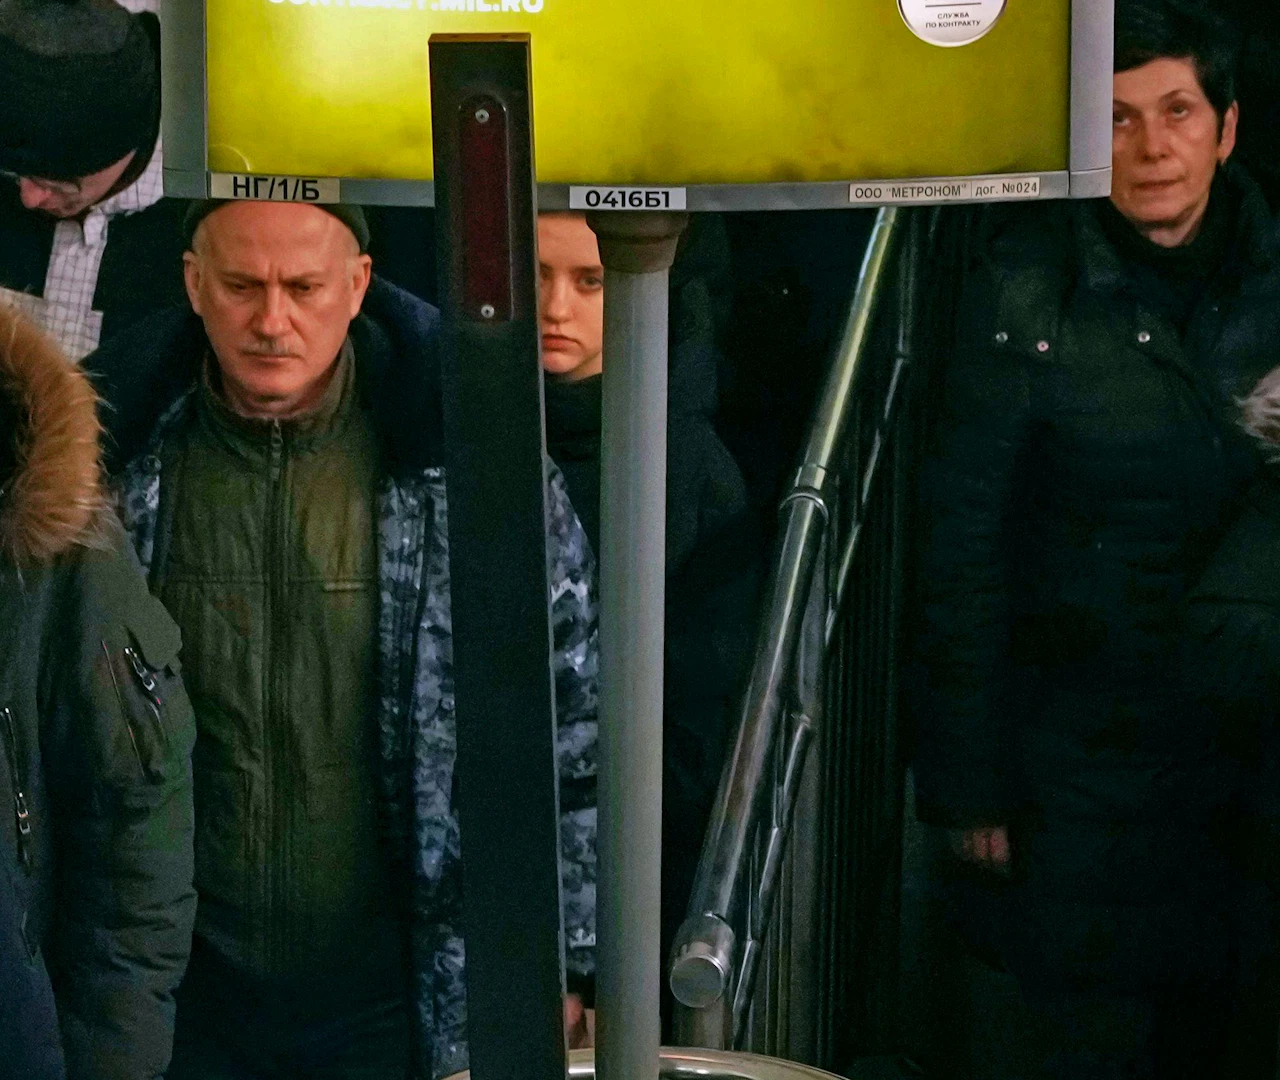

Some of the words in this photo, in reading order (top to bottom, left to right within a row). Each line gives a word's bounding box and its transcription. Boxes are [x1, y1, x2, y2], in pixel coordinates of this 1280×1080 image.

[937, 12, 970, 20] СЛУЖБА
[938, 20, 981, 28] КОНТРАКТУ
[233, 176, 320, 201] НГ/1/Б
[855, 187, 882, 199] ООО
[975, 186, 999, 196] дог.
